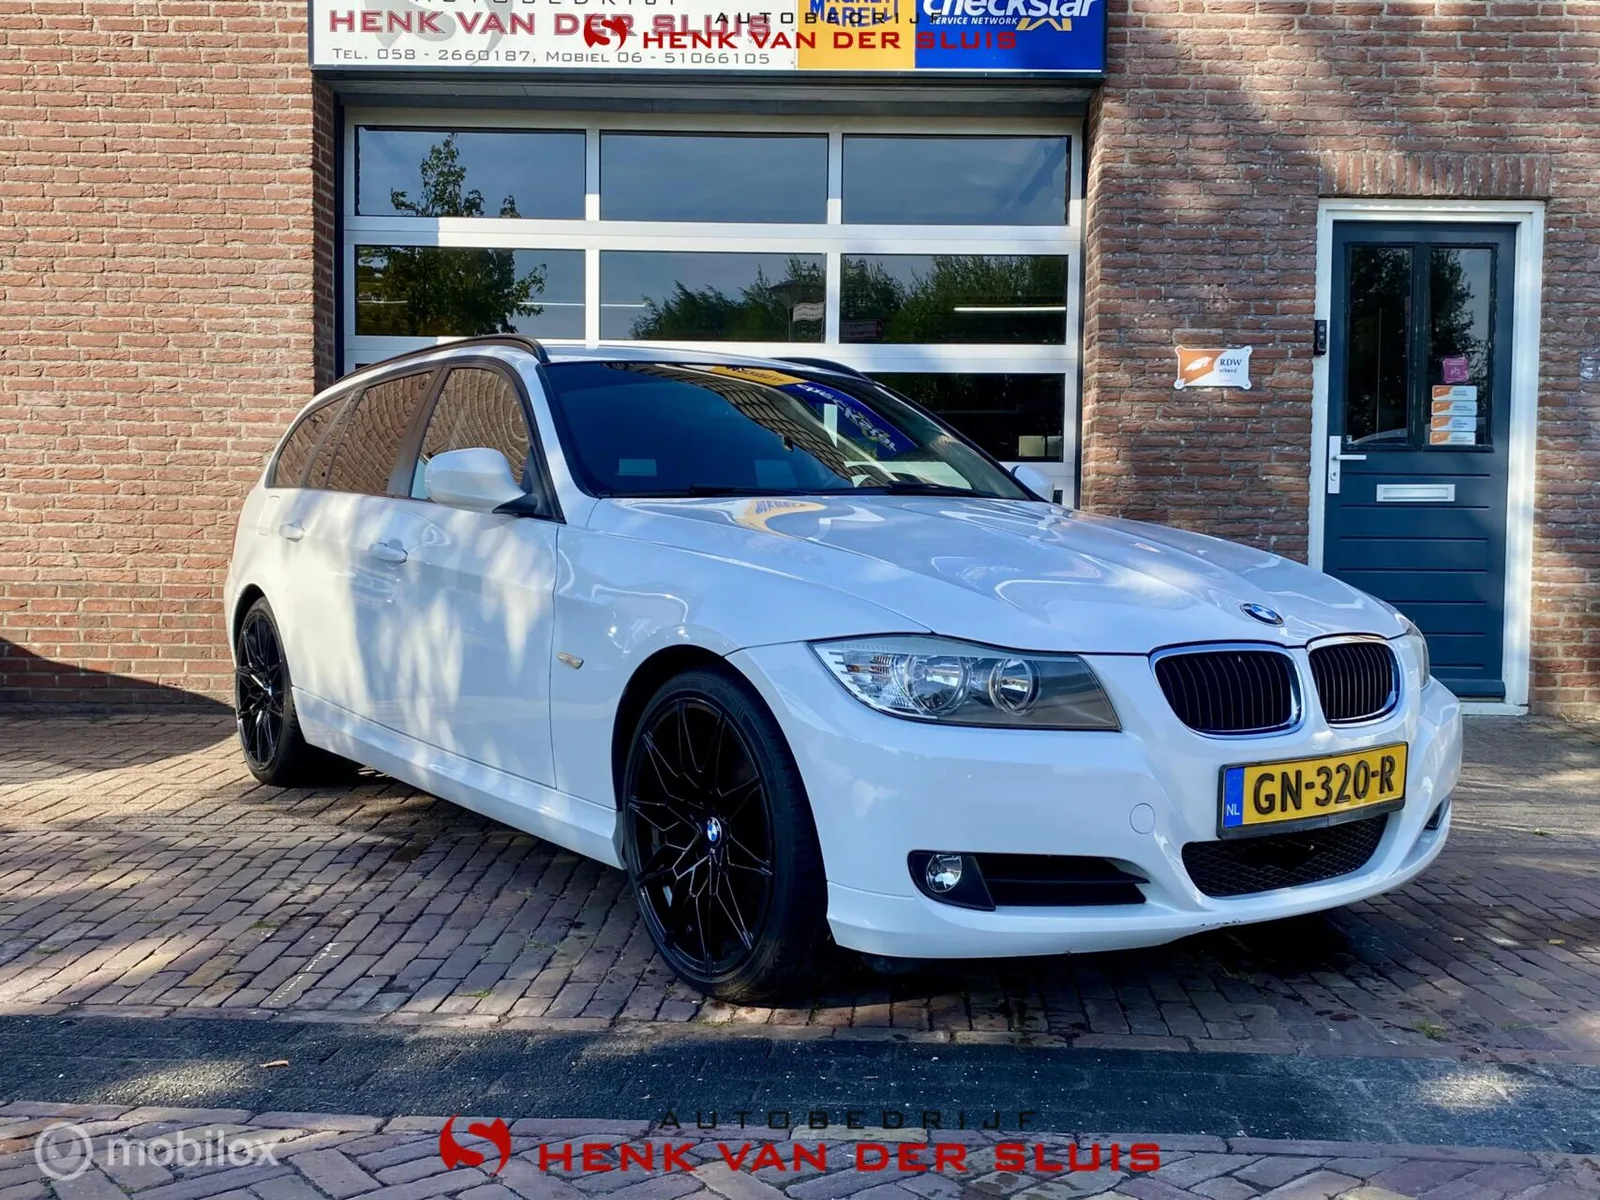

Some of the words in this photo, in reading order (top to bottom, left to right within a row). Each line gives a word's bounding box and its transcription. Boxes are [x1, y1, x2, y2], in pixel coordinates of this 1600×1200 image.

[329, 10, 445, 34] HENK
[455, 11, 535, 35] VAN
[554, 12, 637, 37] DER
[971, 17, 1018, 25] NETWORK
[377, 48, 416, 61] 058
[438, 49, 536, 63] 2660187,
[617, 51, 642, 64] 06
[665, 52, 769, 64] 51066105
[1219, 358, 1242, 366] RDW
[1253, 755, 1396, 815] GN-320-R
[1226, 803, 1241, 816] NL
